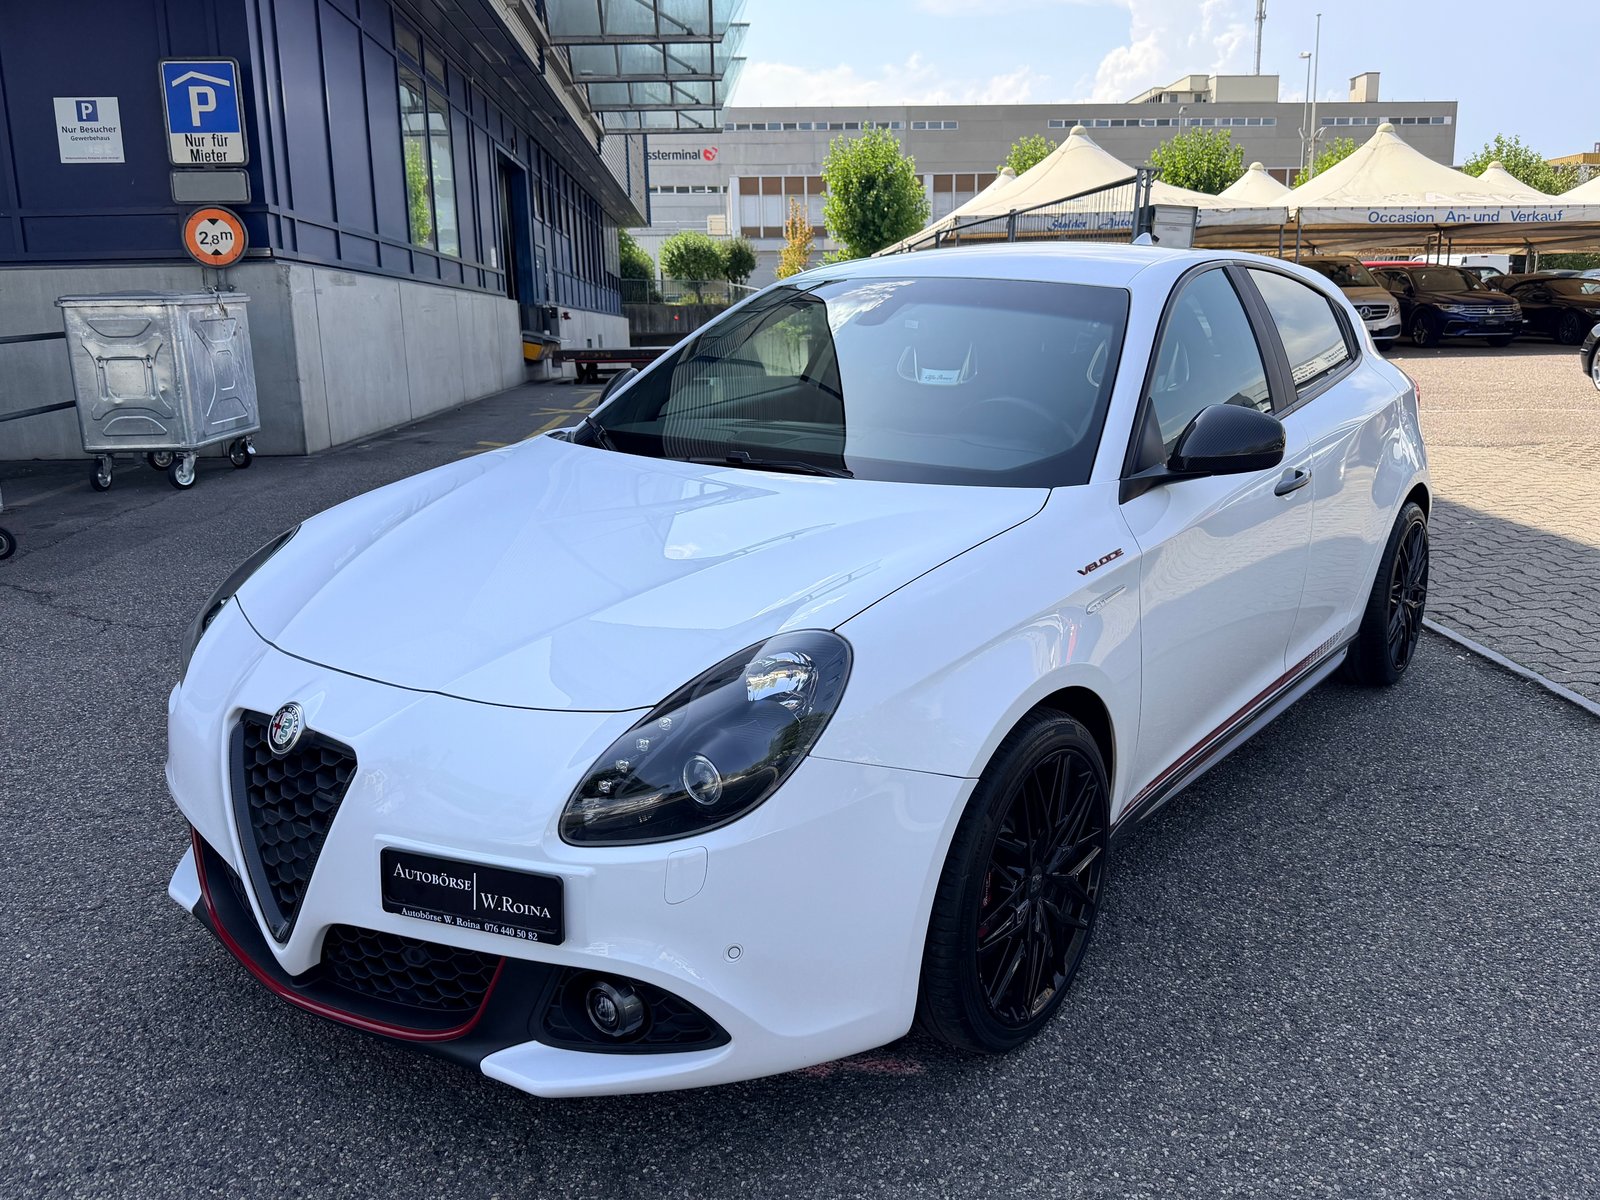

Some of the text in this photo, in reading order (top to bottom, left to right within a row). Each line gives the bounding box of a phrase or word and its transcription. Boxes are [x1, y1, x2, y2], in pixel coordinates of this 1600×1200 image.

[81, 103, 93, 119] P
[188, 86, 217, 127] P
[185, 133, 229, 147] Nur für
[190, 149, 227, 162] Mieter
[1368, 211, 1434, 223] Occasion
[1511, 209, 1563, 222] Verkauf
[1077, 548, 1124, 576] VELOCE
[393, 863, 472, 891] AUTOBÖRSE
[401, 907, 538, 941] Autobörse W. Roina 076 440 50 82
